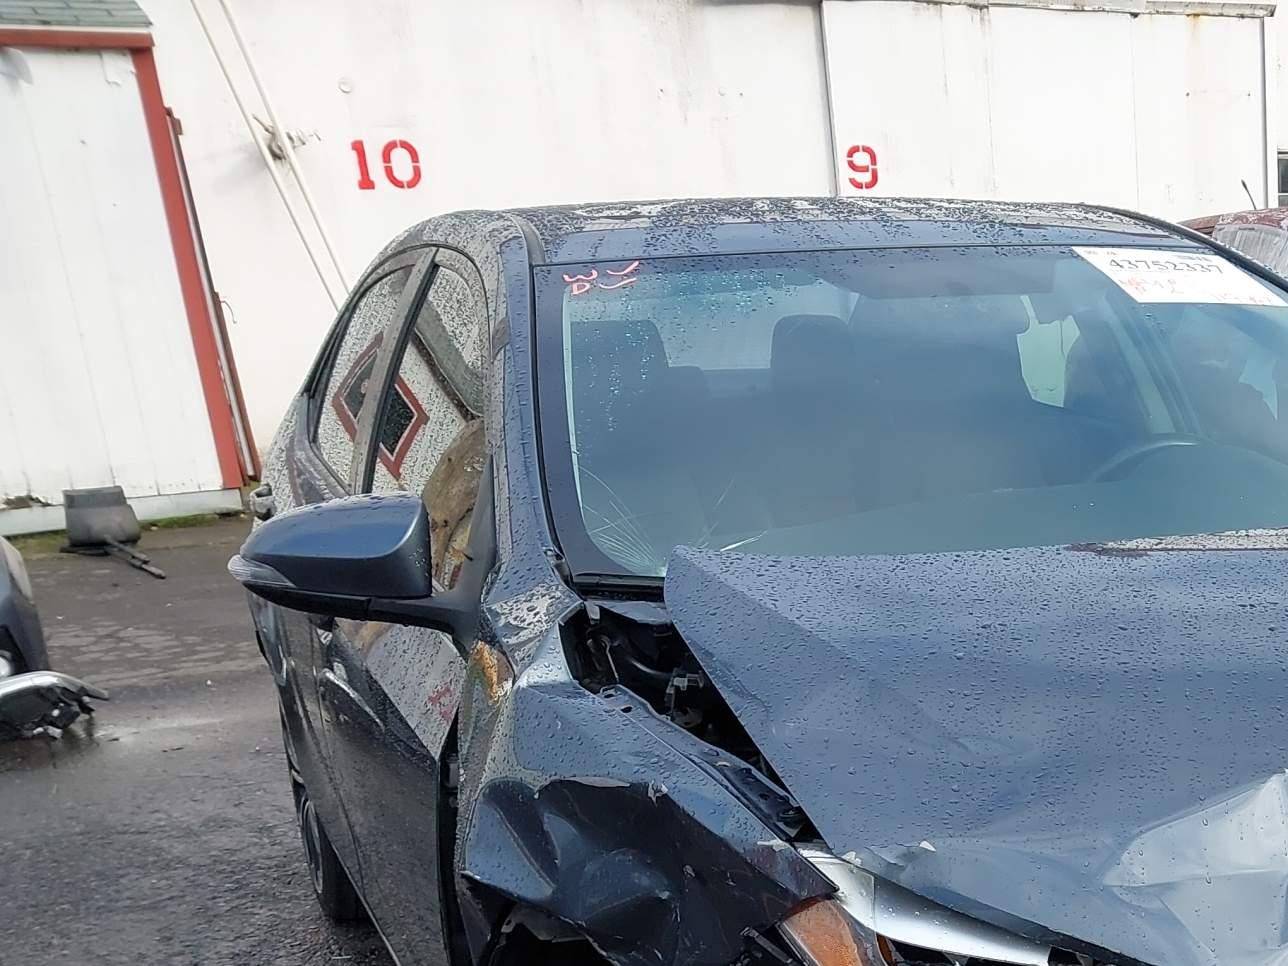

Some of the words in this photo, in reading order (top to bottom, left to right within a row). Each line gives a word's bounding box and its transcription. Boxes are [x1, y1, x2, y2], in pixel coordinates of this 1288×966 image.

[351, 139, 422, 190] 10
[847, 145, 879, 189] 9
[1109, 258, 1223, 274] 43752337
